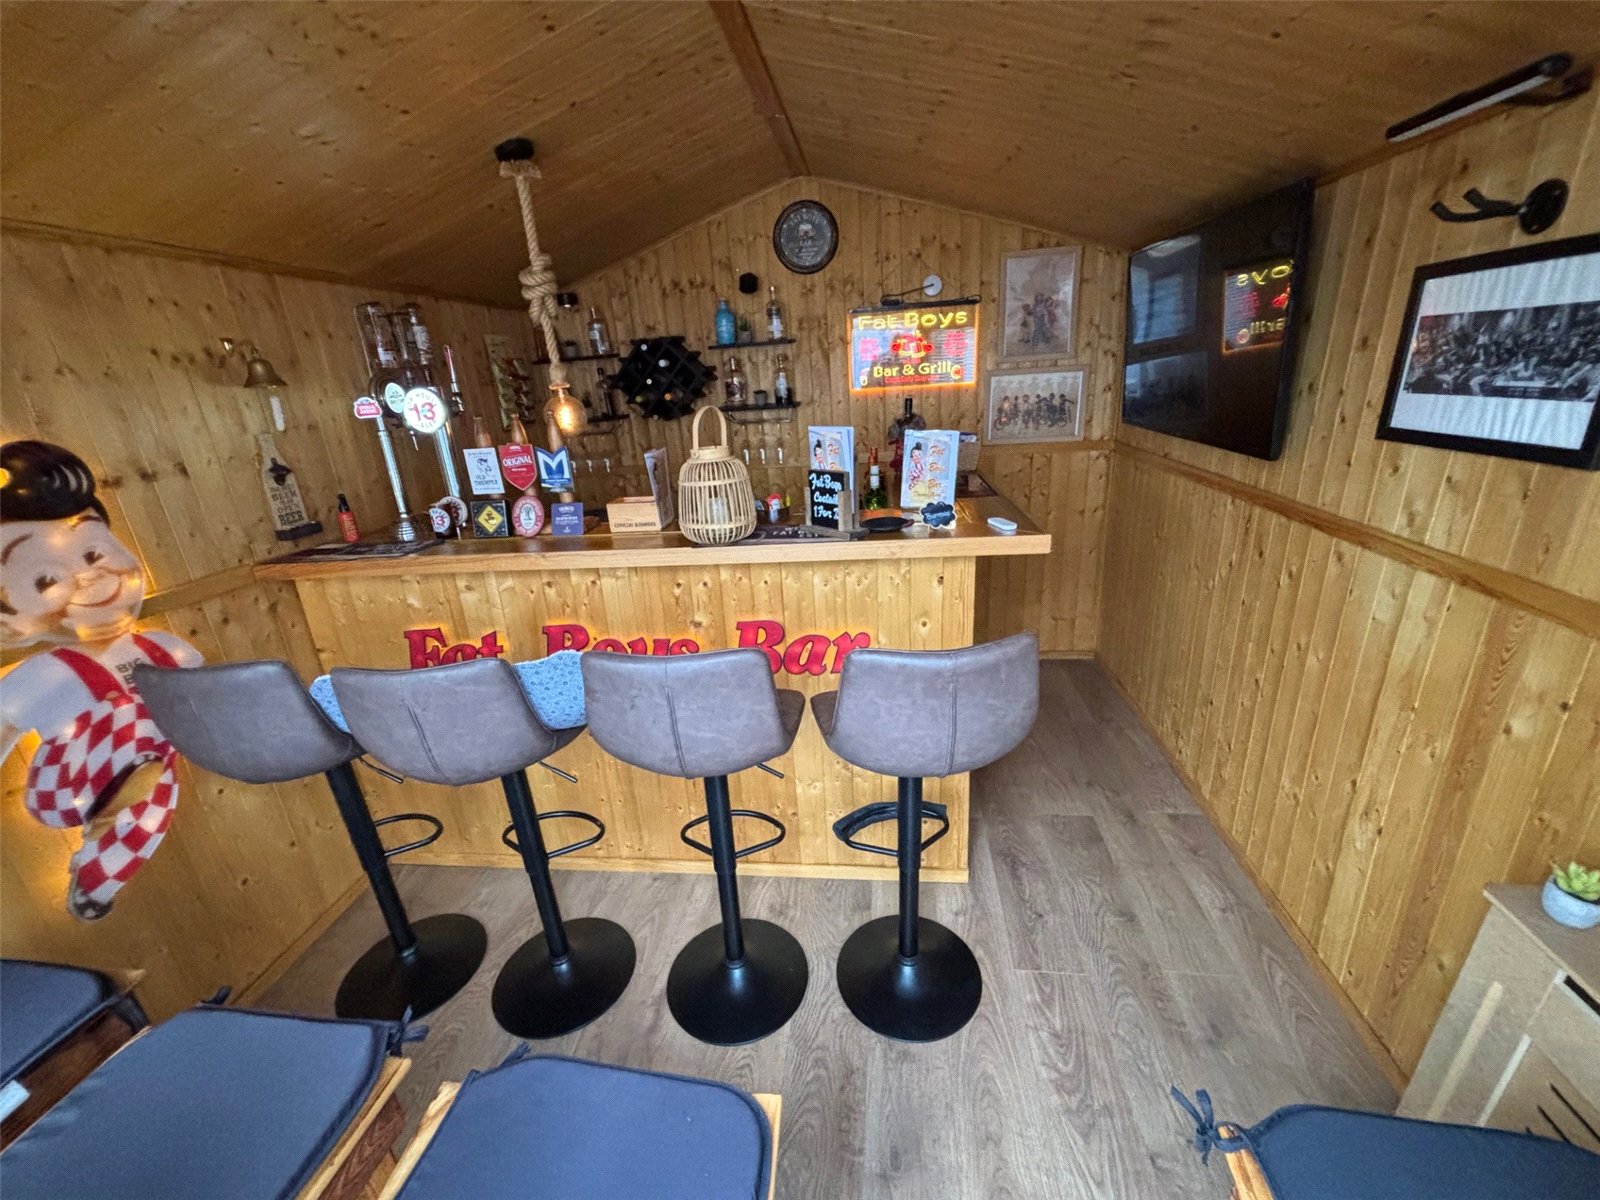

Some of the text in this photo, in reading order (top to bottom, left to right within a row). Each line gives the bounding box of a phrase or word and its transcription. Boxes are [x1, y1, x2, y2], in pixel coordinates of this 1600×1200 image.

[857, 311, 968, 330] Fat Boys
[873, 365, 899, 377] Bar
[902, 364, 915, 376] &
[918, 360, 951, 374] Grill
[411, 402, 436, 422] 13
[502, 455, 533, 467] ORIGINAL
[808, 472, 824, 490] Fat
[278, 510, 304, 525] BEER
[736, 620, 871, 676] Bar
